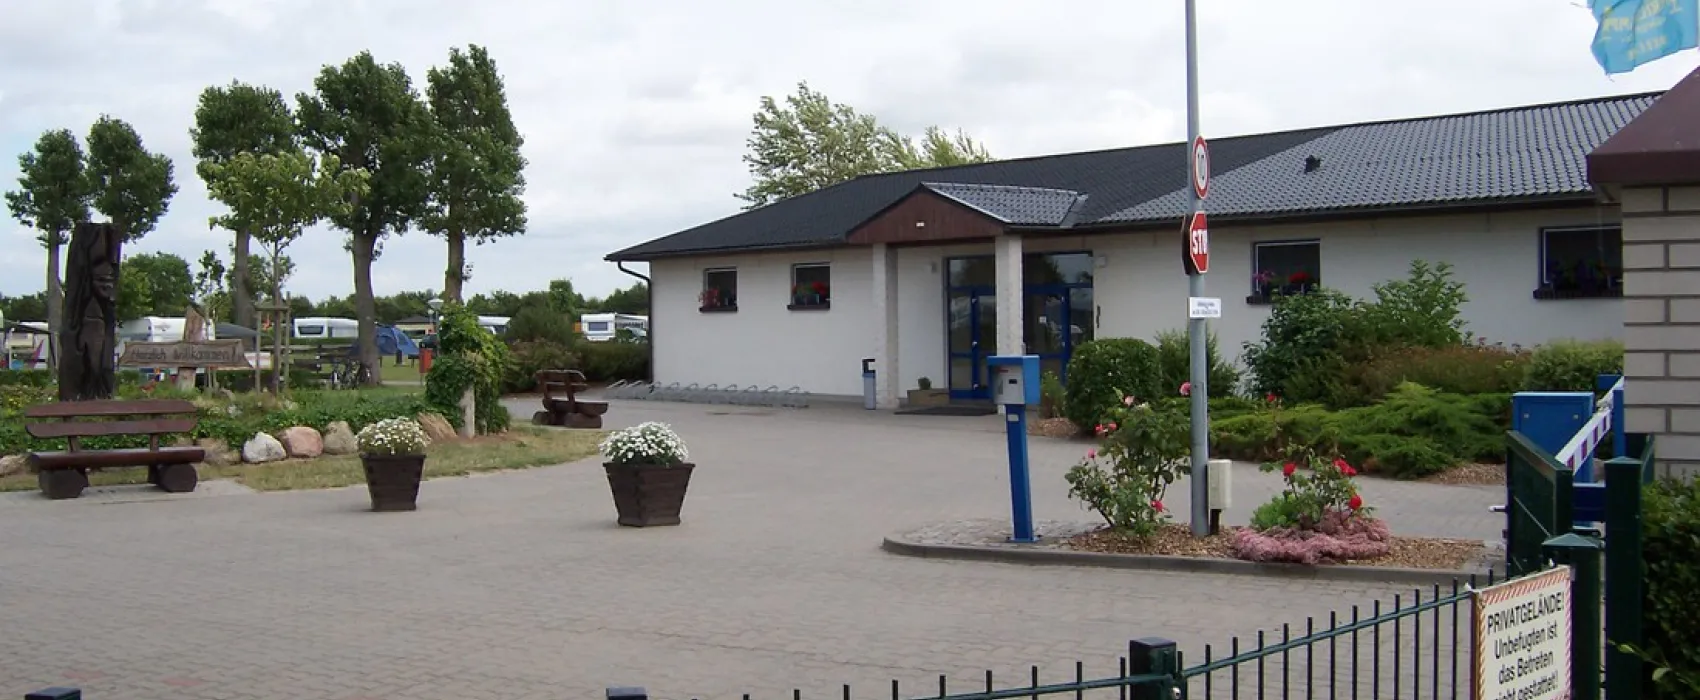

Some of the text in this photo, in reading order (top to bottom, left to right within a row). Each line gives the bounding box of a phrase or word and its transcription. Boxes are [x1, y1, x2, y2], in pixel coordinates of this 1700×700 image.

[1487, 591, 1565, 635] PRIVATGELÄNDE!
[1495, 620, 1558, 660] Unbefugten ist
[1498, 650, 1554, 684] das Betreten
[1493, 687, 1516, 700] iht
